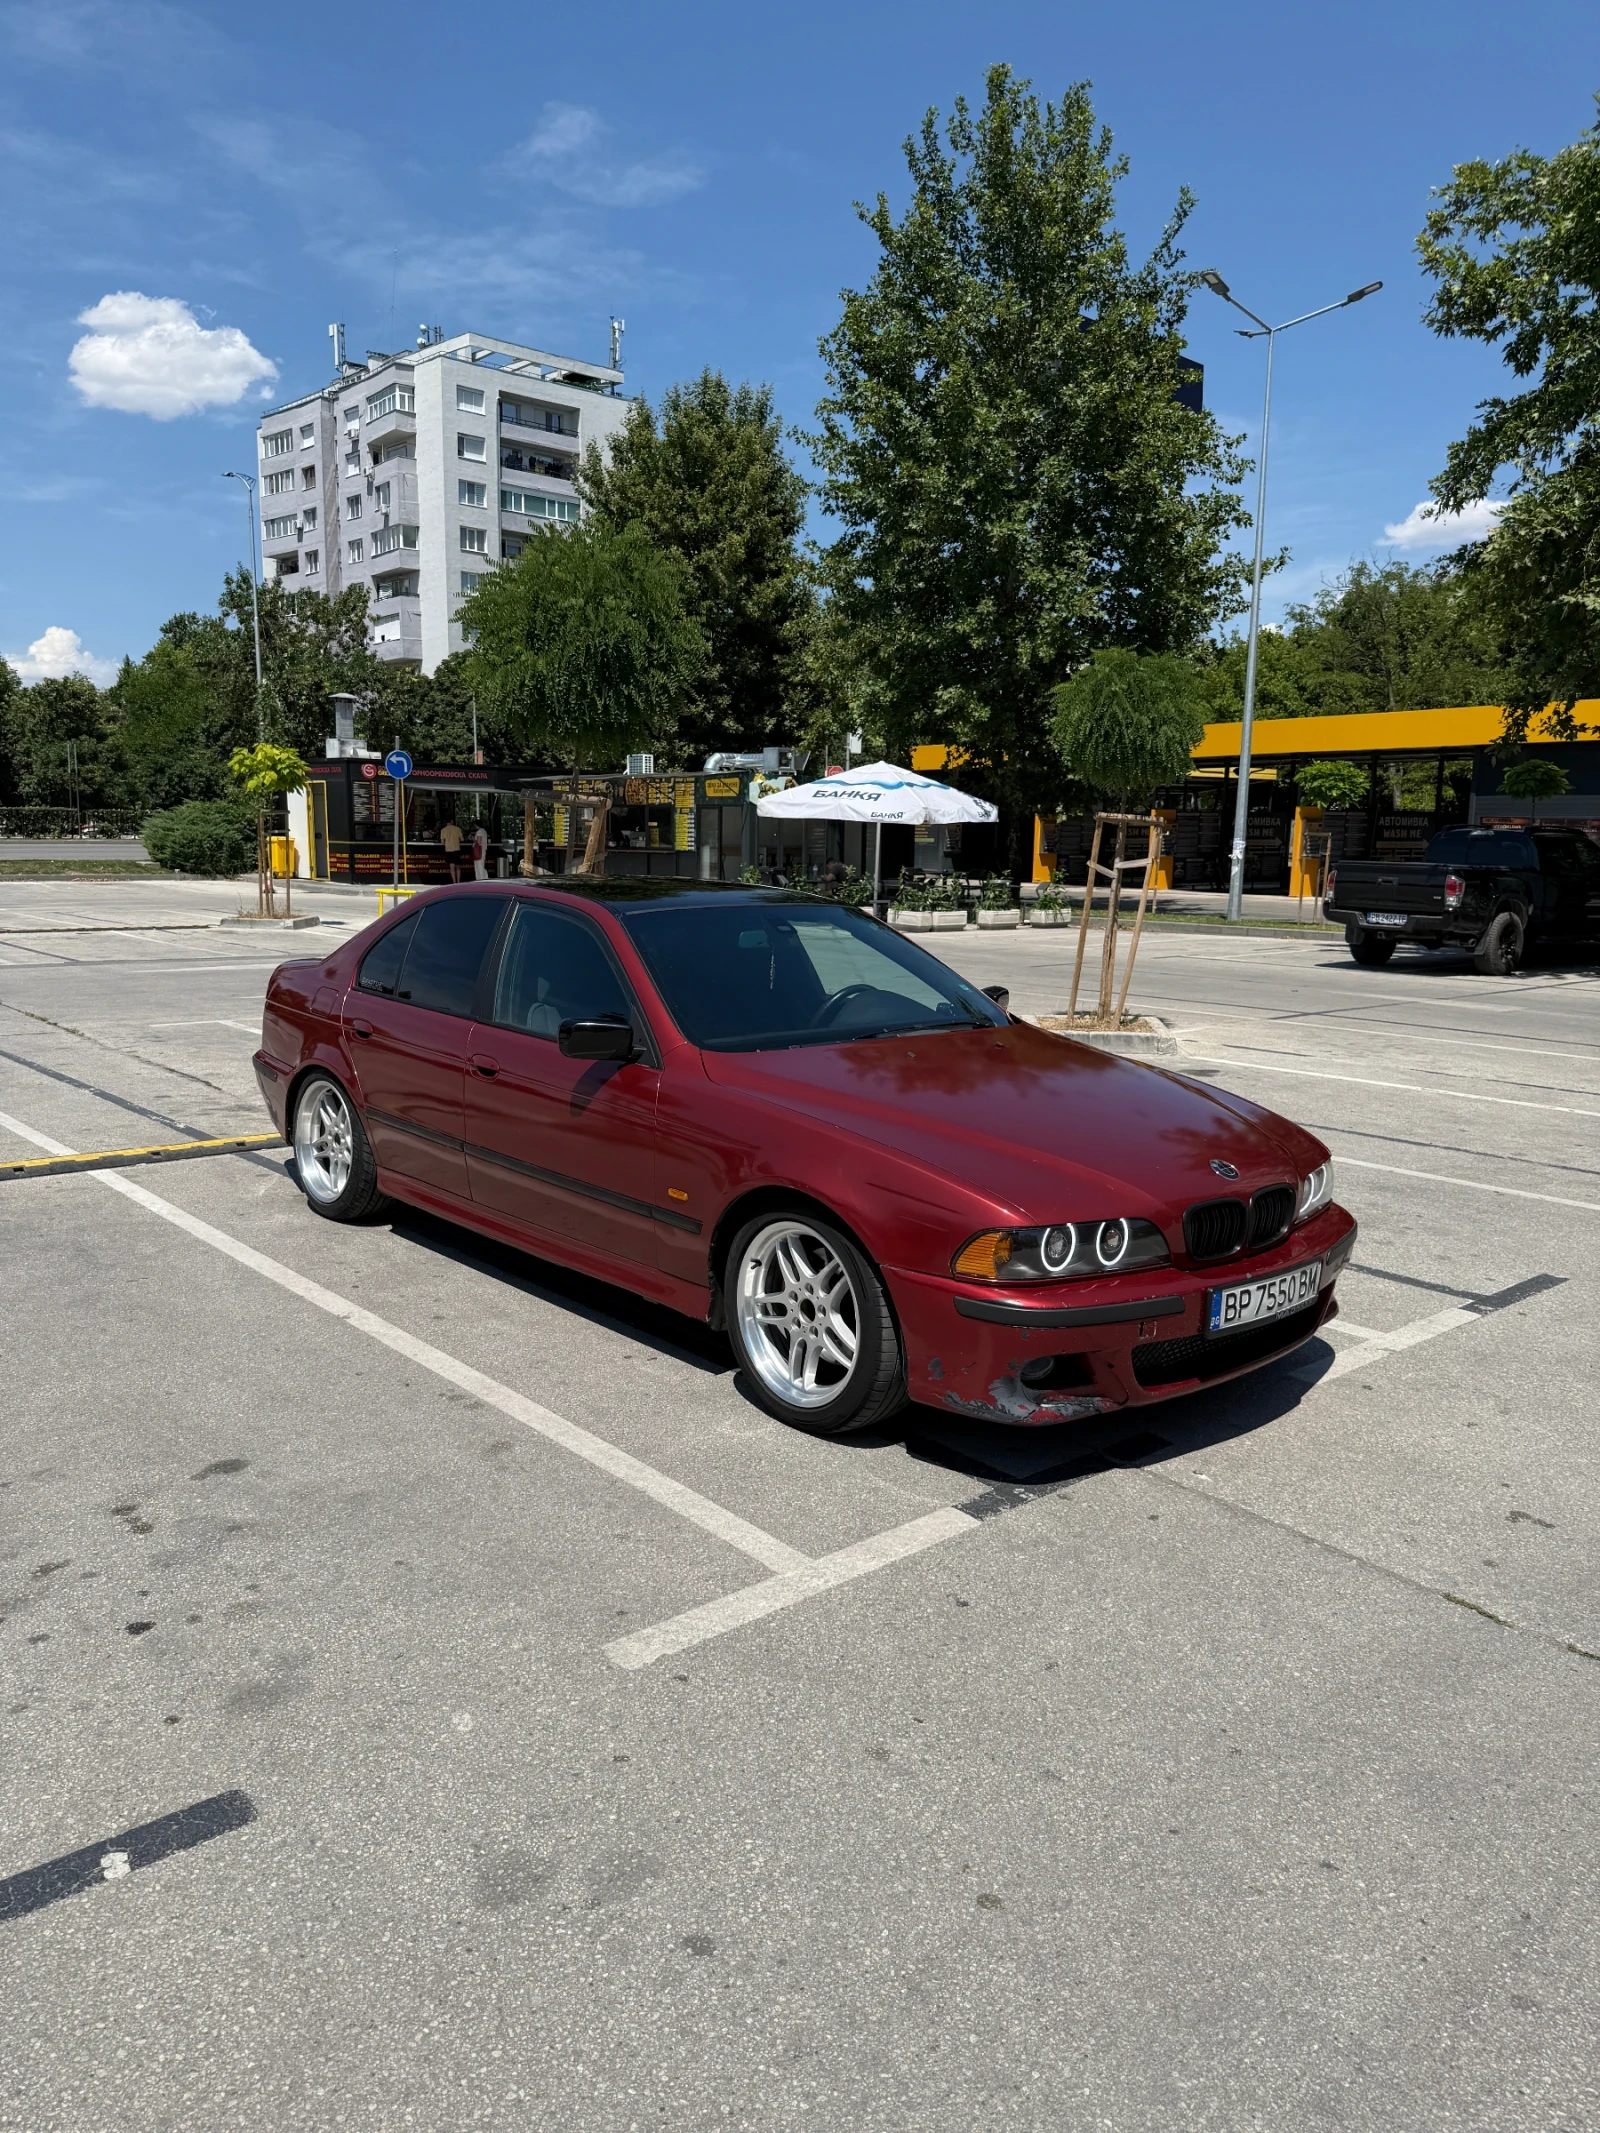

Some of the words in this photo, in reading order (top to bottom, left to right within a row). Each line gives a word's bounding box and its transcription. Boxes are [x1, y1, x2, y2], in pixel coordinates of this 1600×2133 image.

[410, 769, 466, 779] ОРНООРЯХОВСКА
[812, 790, 882, 801] БАНКЯ
[870, 811, 904, 819] БАНКЯ
[1378, 816, 1429, 827] АВТОМИВКА
[1262, 828, 1275, 837] ME
[1383, 828, 1408, 839] WASH
[1409, 828, 1422, 839] ME
[1224, 1290, 1251, 1323] BP
[1254, 1275, 1296, 1317] 7550
[1298, 1267, 1318, 1299] BM
[1210, 1316, 1220, 1326] BG
